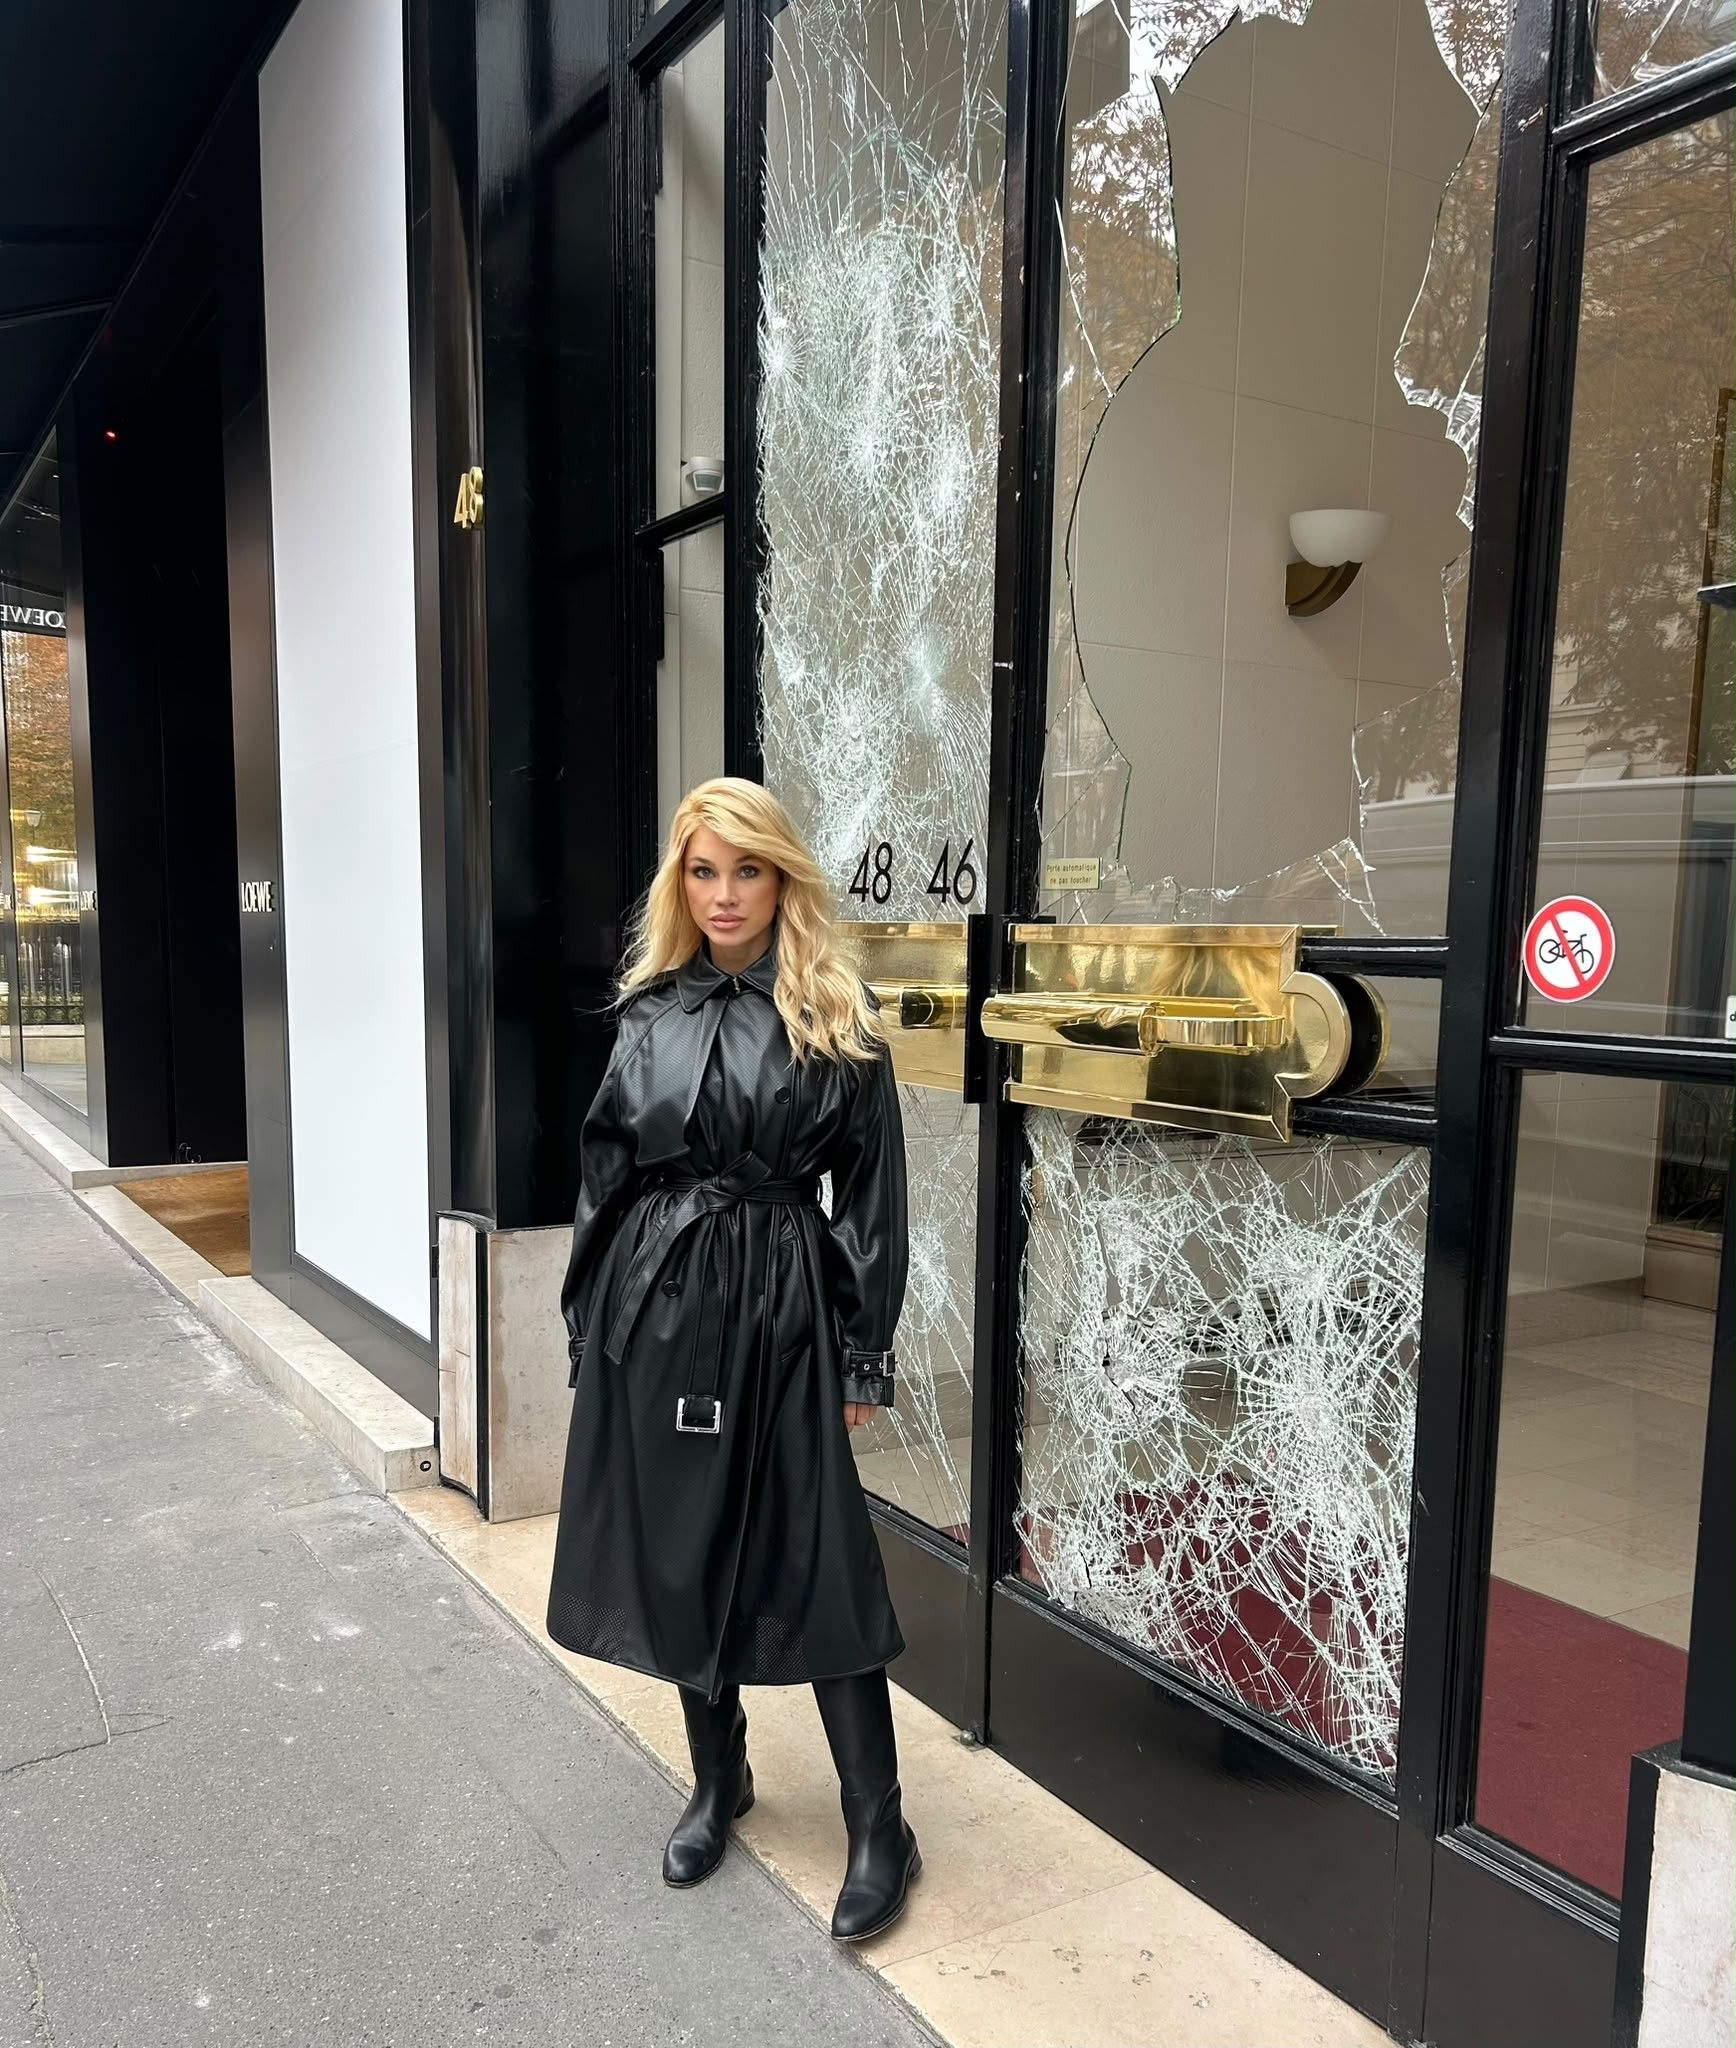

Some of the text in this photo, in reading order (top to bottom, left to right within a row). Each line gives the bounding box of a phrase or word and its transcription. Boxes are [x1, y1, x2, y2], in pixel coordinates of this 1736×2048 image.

[454, 466, 484, 528] 48
[849, 838, 977, 904] 48 46
[1046, 863, 1096, 872] Porte automatique
[1070, 876, 1092, 884] toucher
[241, 881, 272, 912] LOEWE
